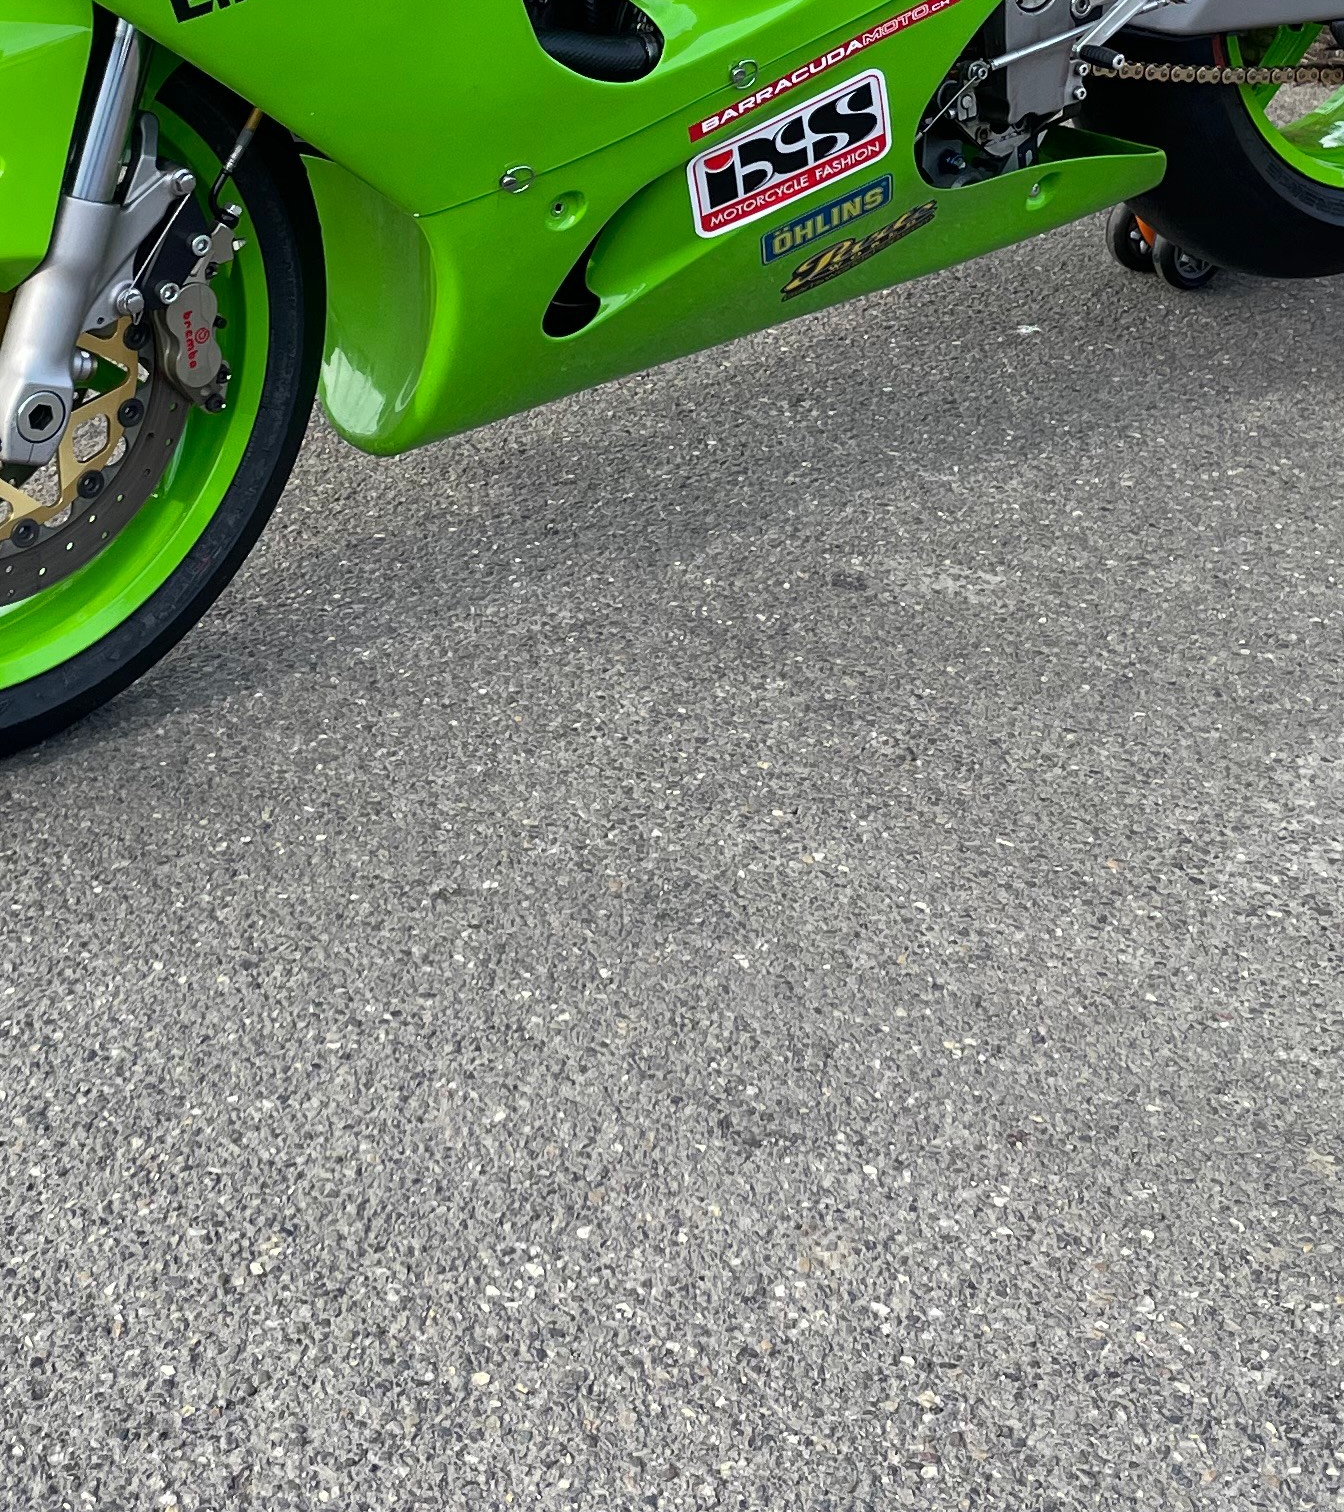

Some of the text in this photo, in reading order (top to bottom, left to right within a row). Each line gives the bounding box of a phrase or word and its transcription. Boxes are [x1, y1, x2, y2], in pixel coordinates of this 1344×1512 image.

[709, 141, 882, 227] MOTORCYCLE FASHION
[772, 186, 885, 256] ÖHLINS
[182, 310, 198, 370] brembo
